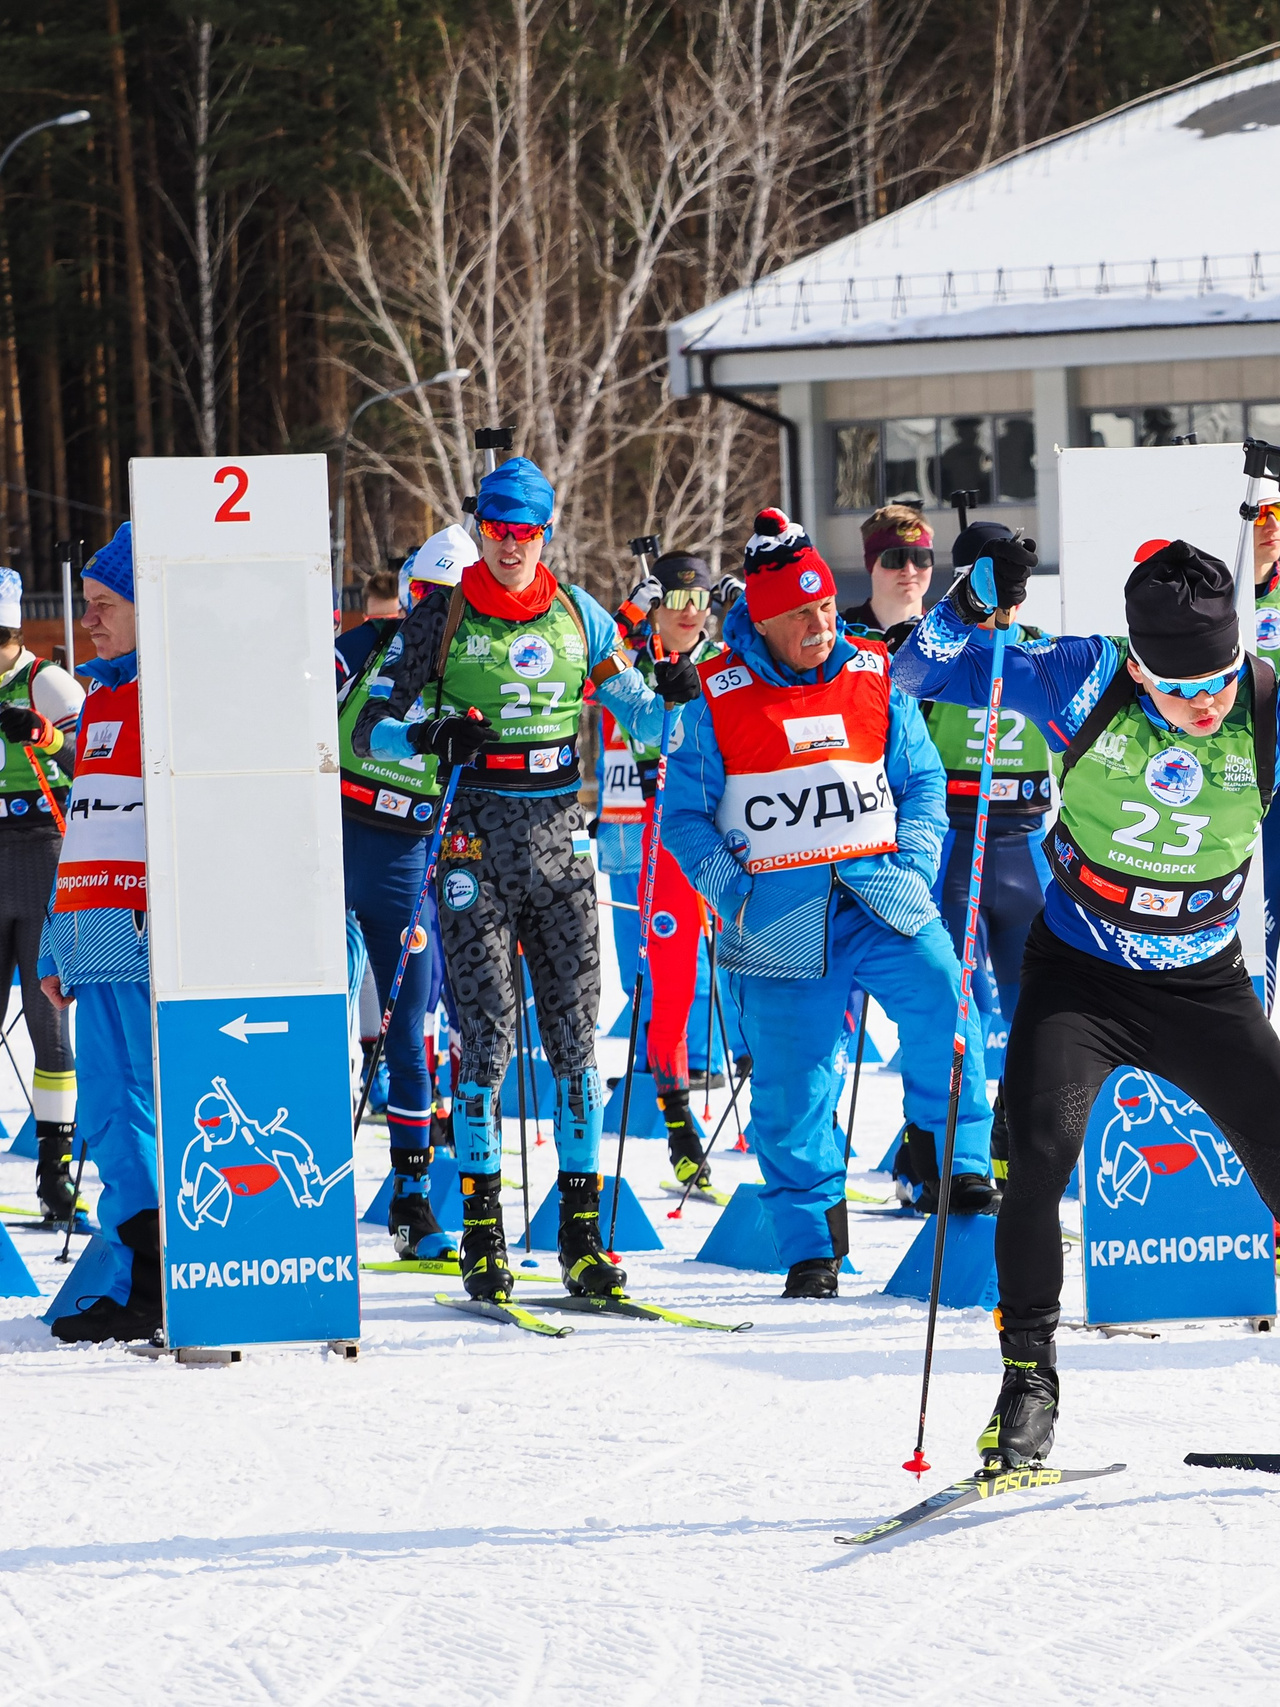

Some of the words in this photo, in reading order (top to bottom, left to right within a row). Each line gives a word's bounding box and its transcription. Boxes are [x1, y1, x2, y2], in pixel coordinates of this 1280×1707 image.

[214, 466, 250, 522] 2
[855, 653, 877, 669] 35
[715, 669, 742, 691] 35
[500, 681, 566, 719] 27
[501, 724, 561, 737] КРАСНОЯРСК
[966, 709, 1026, 751] 32
[361, 761, 423, 788] КРАСНОЯРСК
[656, 753, 668, 791] KV+
[744, 773, 892, 832] СУДЬЯ
[1111, 800, 1211, 857] 23
[1107, 849, 1196, 874] КРАСНОЯРСК
[114, 873, 147, 890] кра
[407, 1155, 424, 1164] 181
[569, 1178, 587, 1188] 177
[1090, 1233, 1270, 1267] КРАСНОЯРСК
[171, 1255, 354, 1290] КРАСНОЯРСК
[418, 1262, 443, 1270] FISCHER
[1001, 1357, 1038, 1369] CHER
[993, 1470, 1062, 1496] FISCHER
